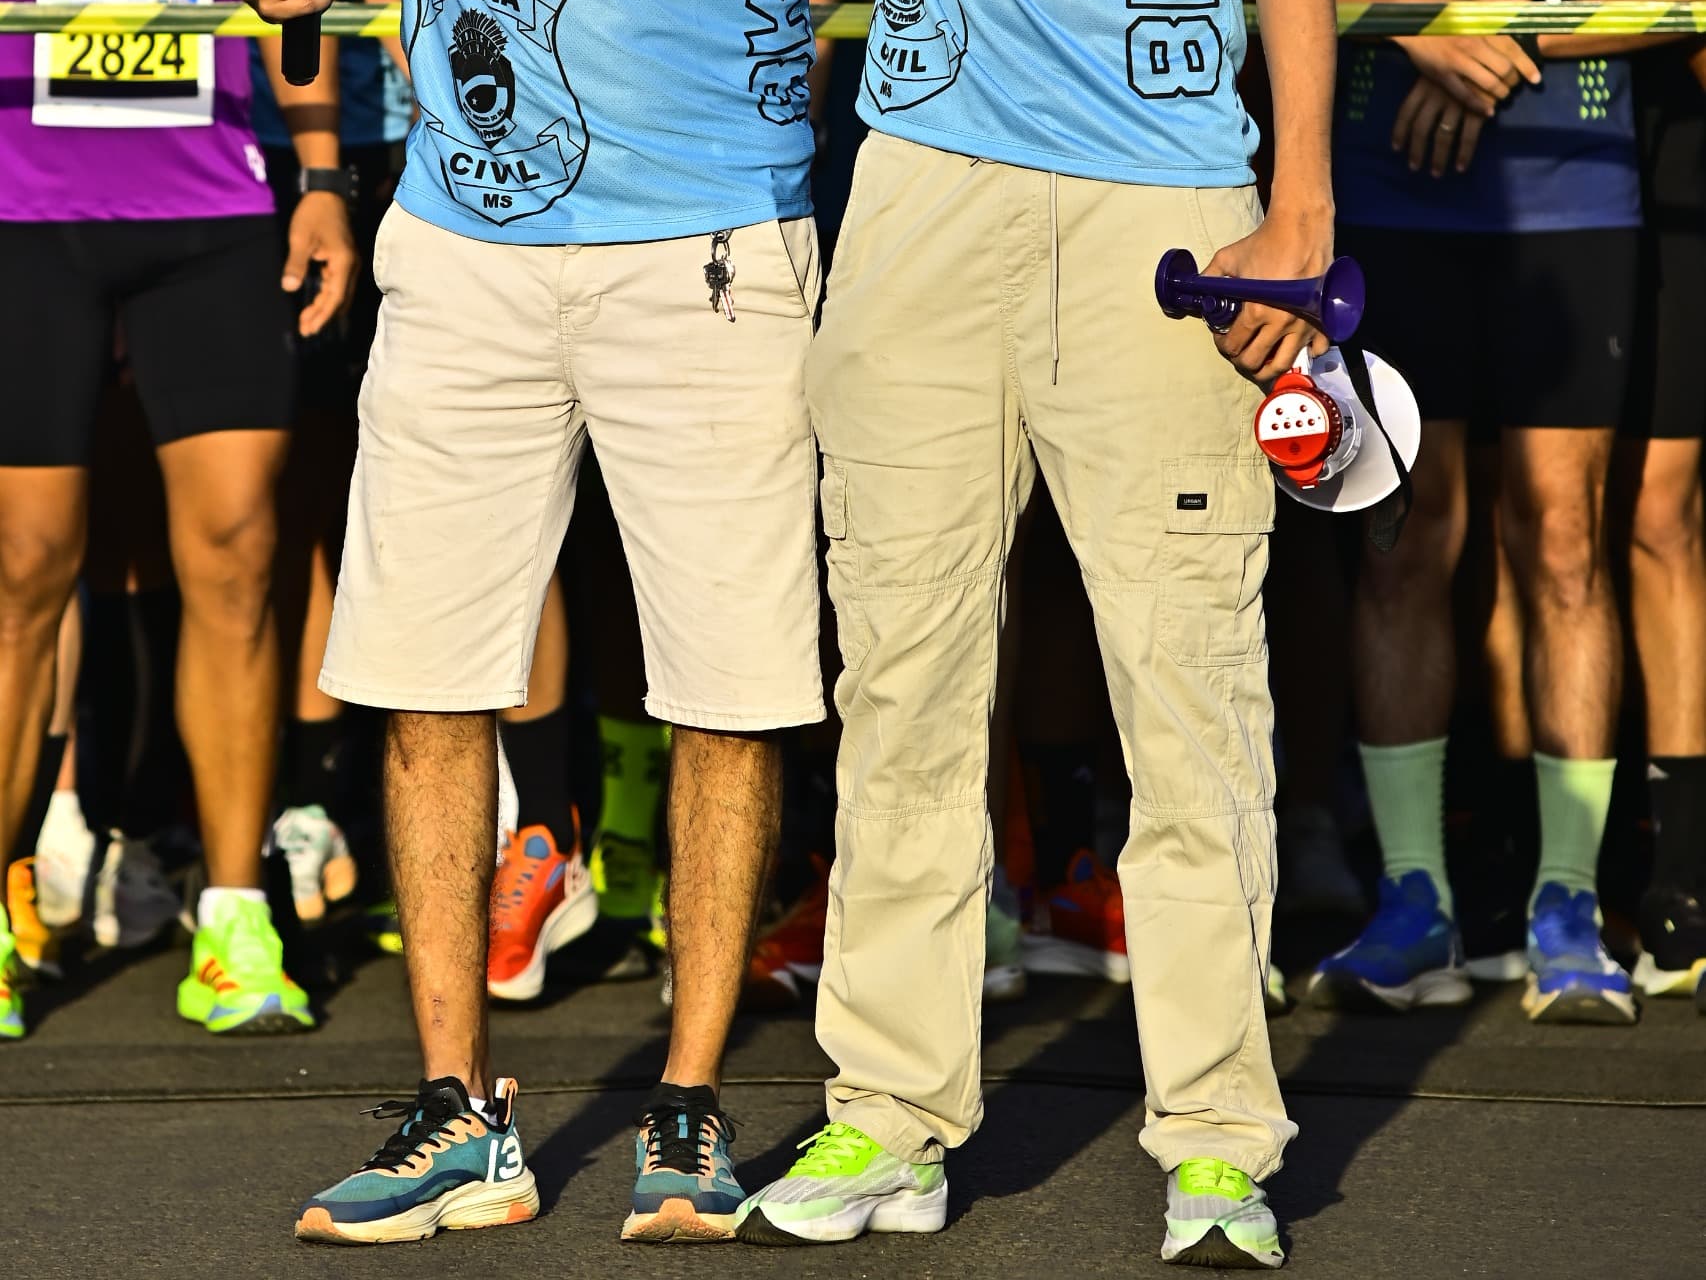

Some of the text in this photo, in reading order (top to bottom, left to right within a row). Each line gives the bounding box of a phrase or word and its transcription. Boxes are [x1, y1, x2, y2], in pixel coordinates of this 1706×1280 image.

[67, 32, 186, 77] 2824
[879, 80, 892, 98] MS
[449, 151, 541, 184] CIVIL
[483, 193, 513, 209] MS
